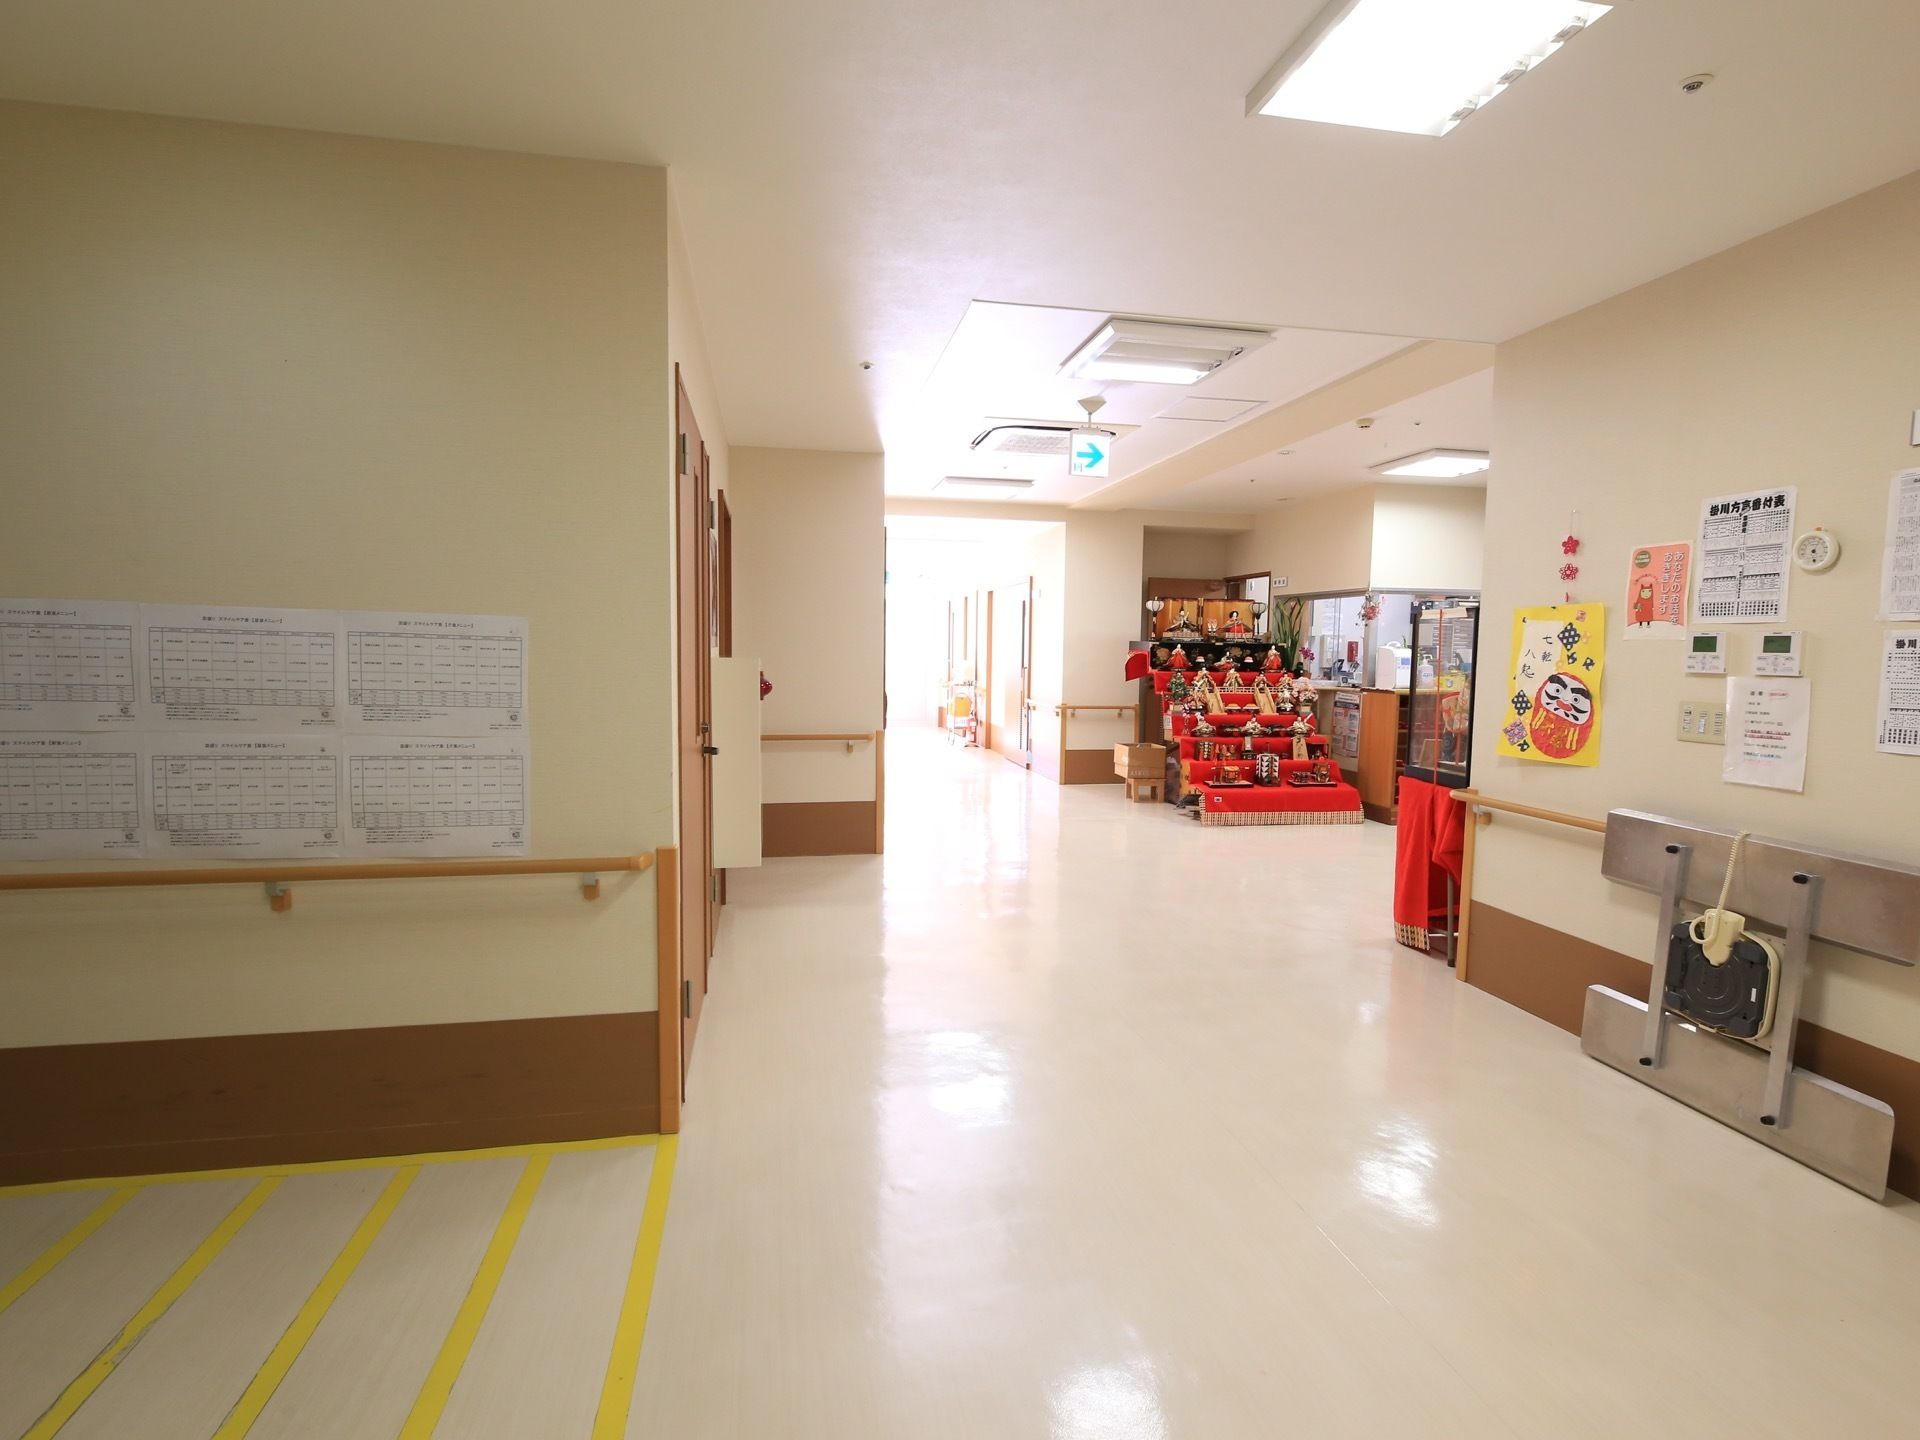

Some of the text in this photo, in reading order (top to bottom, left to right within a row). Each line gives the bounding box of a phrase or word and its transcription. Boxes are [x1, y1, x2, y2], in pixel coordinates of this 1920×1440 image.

[1709, 494, 1786, 517] 掛川方言番付表
[1658, 552, 1673, 615] おききします
[1670, 551, 1685, 626] あなたのお話を
